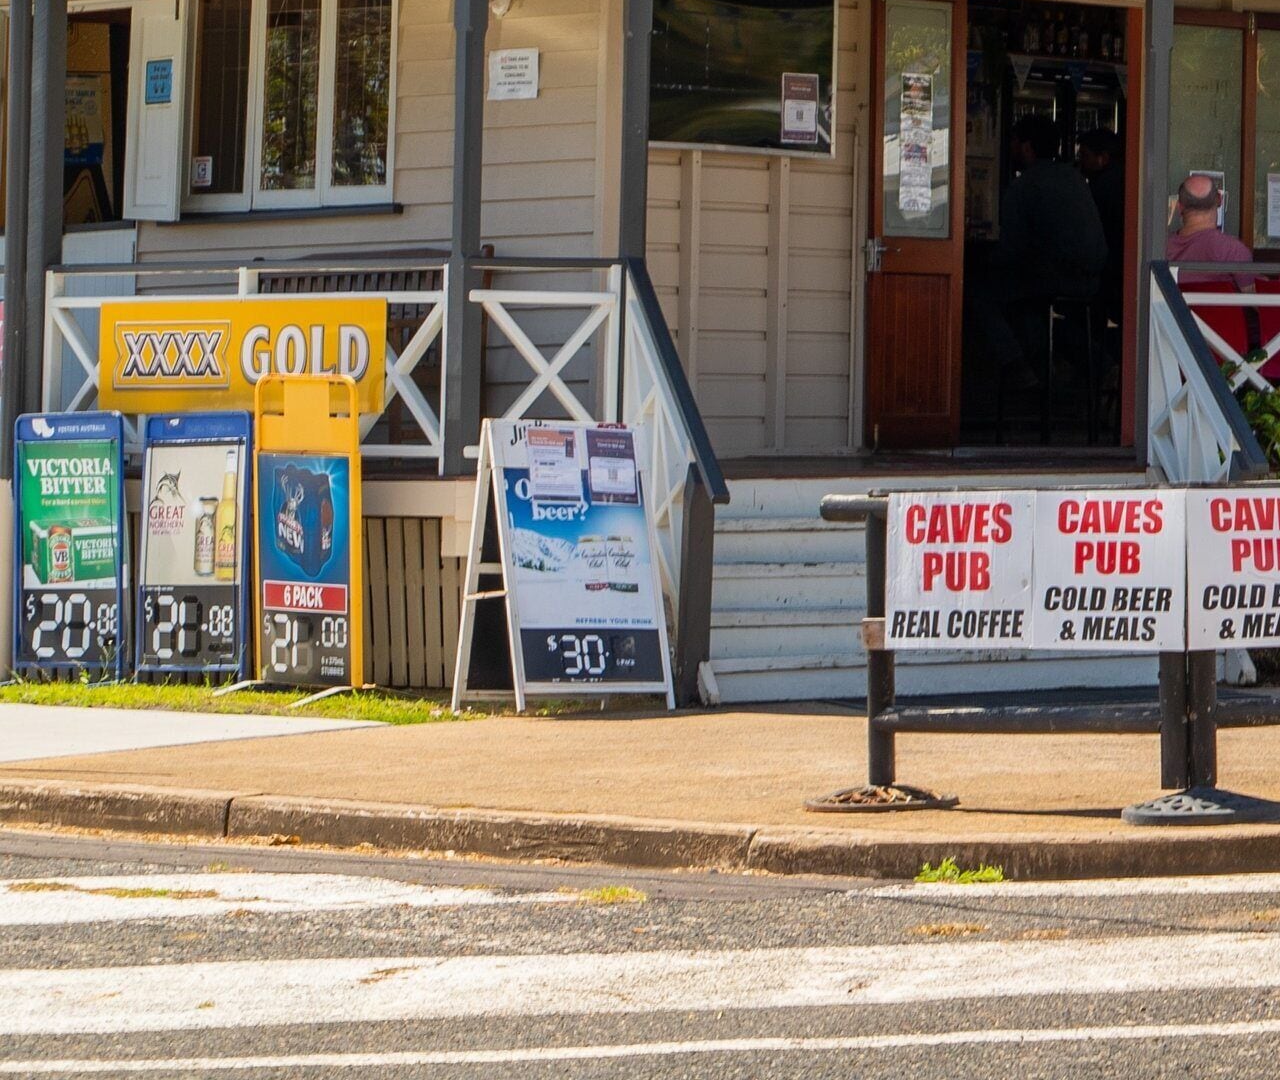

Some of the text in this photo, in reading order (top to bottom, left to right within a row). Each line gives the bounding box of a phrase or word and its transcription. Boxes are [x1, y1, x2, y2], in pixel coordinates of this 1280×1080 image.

[122, 329, 223, 379] XXXX
[239, 323, 370, 385] GOLD
[27, 457, 114, 477] VICTORIA
[40, 476, 107, 496] BITTER
[150, 505, 186, 520] GREAT
[532, 501, 589, 521] beer?
[905, 502, 1013, 545] CAVES
[1058, 499, 1164, 534] CAVES
[54, 551, 68, 562] VB
[81, 548, 114, 560] BITTER
[1074, 541, 1141, 575] PUB
[922, 551, 991, 592] PUB
[283, 586, 323, 609] 6 PACK
[1044, 586, 1173, 612] COLD BEER
[1202, 584, 1266, 610] COLD
[890, 609, 1025, 639] REAL COFFEE
[1059, 616, 1157, 642] & MEALS
[1219, 618, 1236, 639] &
